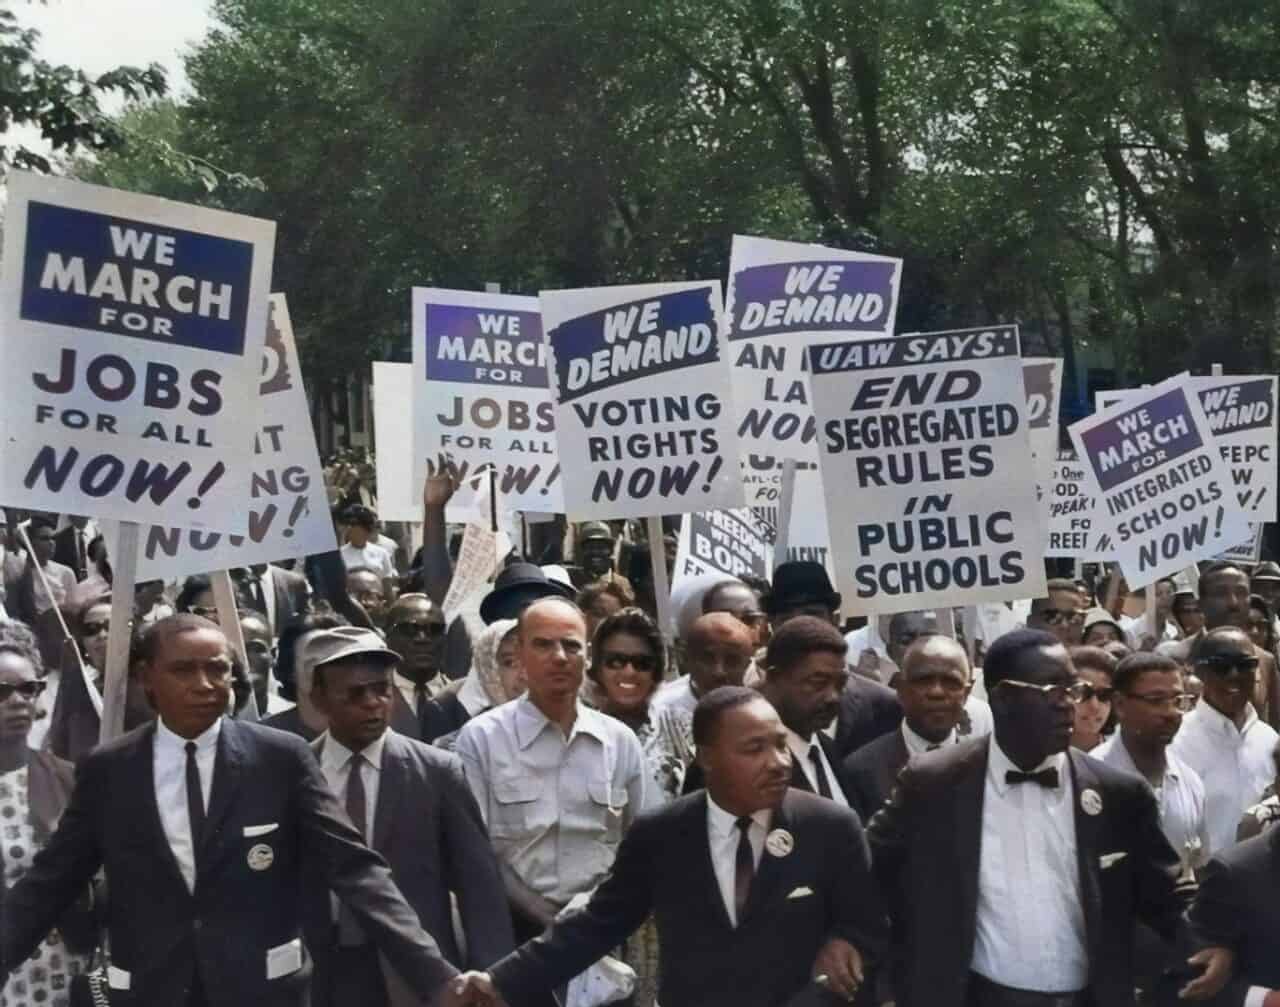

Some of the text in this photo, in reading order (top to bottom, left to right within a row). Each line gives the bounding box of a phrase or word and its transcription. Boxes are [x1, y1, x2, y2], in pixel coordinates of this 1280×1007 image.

[110, 226, 175, 266] WE
[40, 253, 233, 320] MARCH
[783, 265, 845, 297] WE
[100, 307, 173, 337] FOR
[478, 313, 520, 336] WE
[603, 301, 662, 344] WE
[740, 293, 884, 331] DEMAND
[566, 322, 712, 392] DEMAND
[735, 343, 786, 372] AN
[819, 341, 899, 370] UAW
[903, 330, 1012, 362] SAYS:
[32, 348, 223, 416] JOBS
[475, 367, 522, 383] FOR
[764, 377, 808, 405] LA
[850, 369, 982, 411] END
[436, 396, 555, 433] JOBS
[572, 391, 722, 429] VOTING
[1204, 386, 1241, 411] WE
[1208, 401, 1269, 432] MAND
[36, 405, 213, 447] FOR ALL
[824, 403, 1019, 454] SEGREGATED
[1116, 408, 1152, 436] WE
[441, 434, 553, 455] FOR ALL
[589, 428, 719, 463] RIGHTS
[1100, 413, 1189, 473] MARCH
[1131, 451, 1168, 473] FOR
[24, 445, 225, 509] NOW!
[591, 455, 723, 504] NOW!
[855, 444, 994, 488] RULES
[1106, 454, 1213, 517] INTEGRATED
[755, 487, 779, 501] FO
[902, 494, 952, 515] IN
[1117, 481, 1223, 542] SCHOOLS
[857, 511, 1015, 558] PUBLIC
[1071, 519, 1091, 530] FO
[1139, 505, 1225, 572] NOW!
[855, 550, 1025, 598] SCHOOLS
